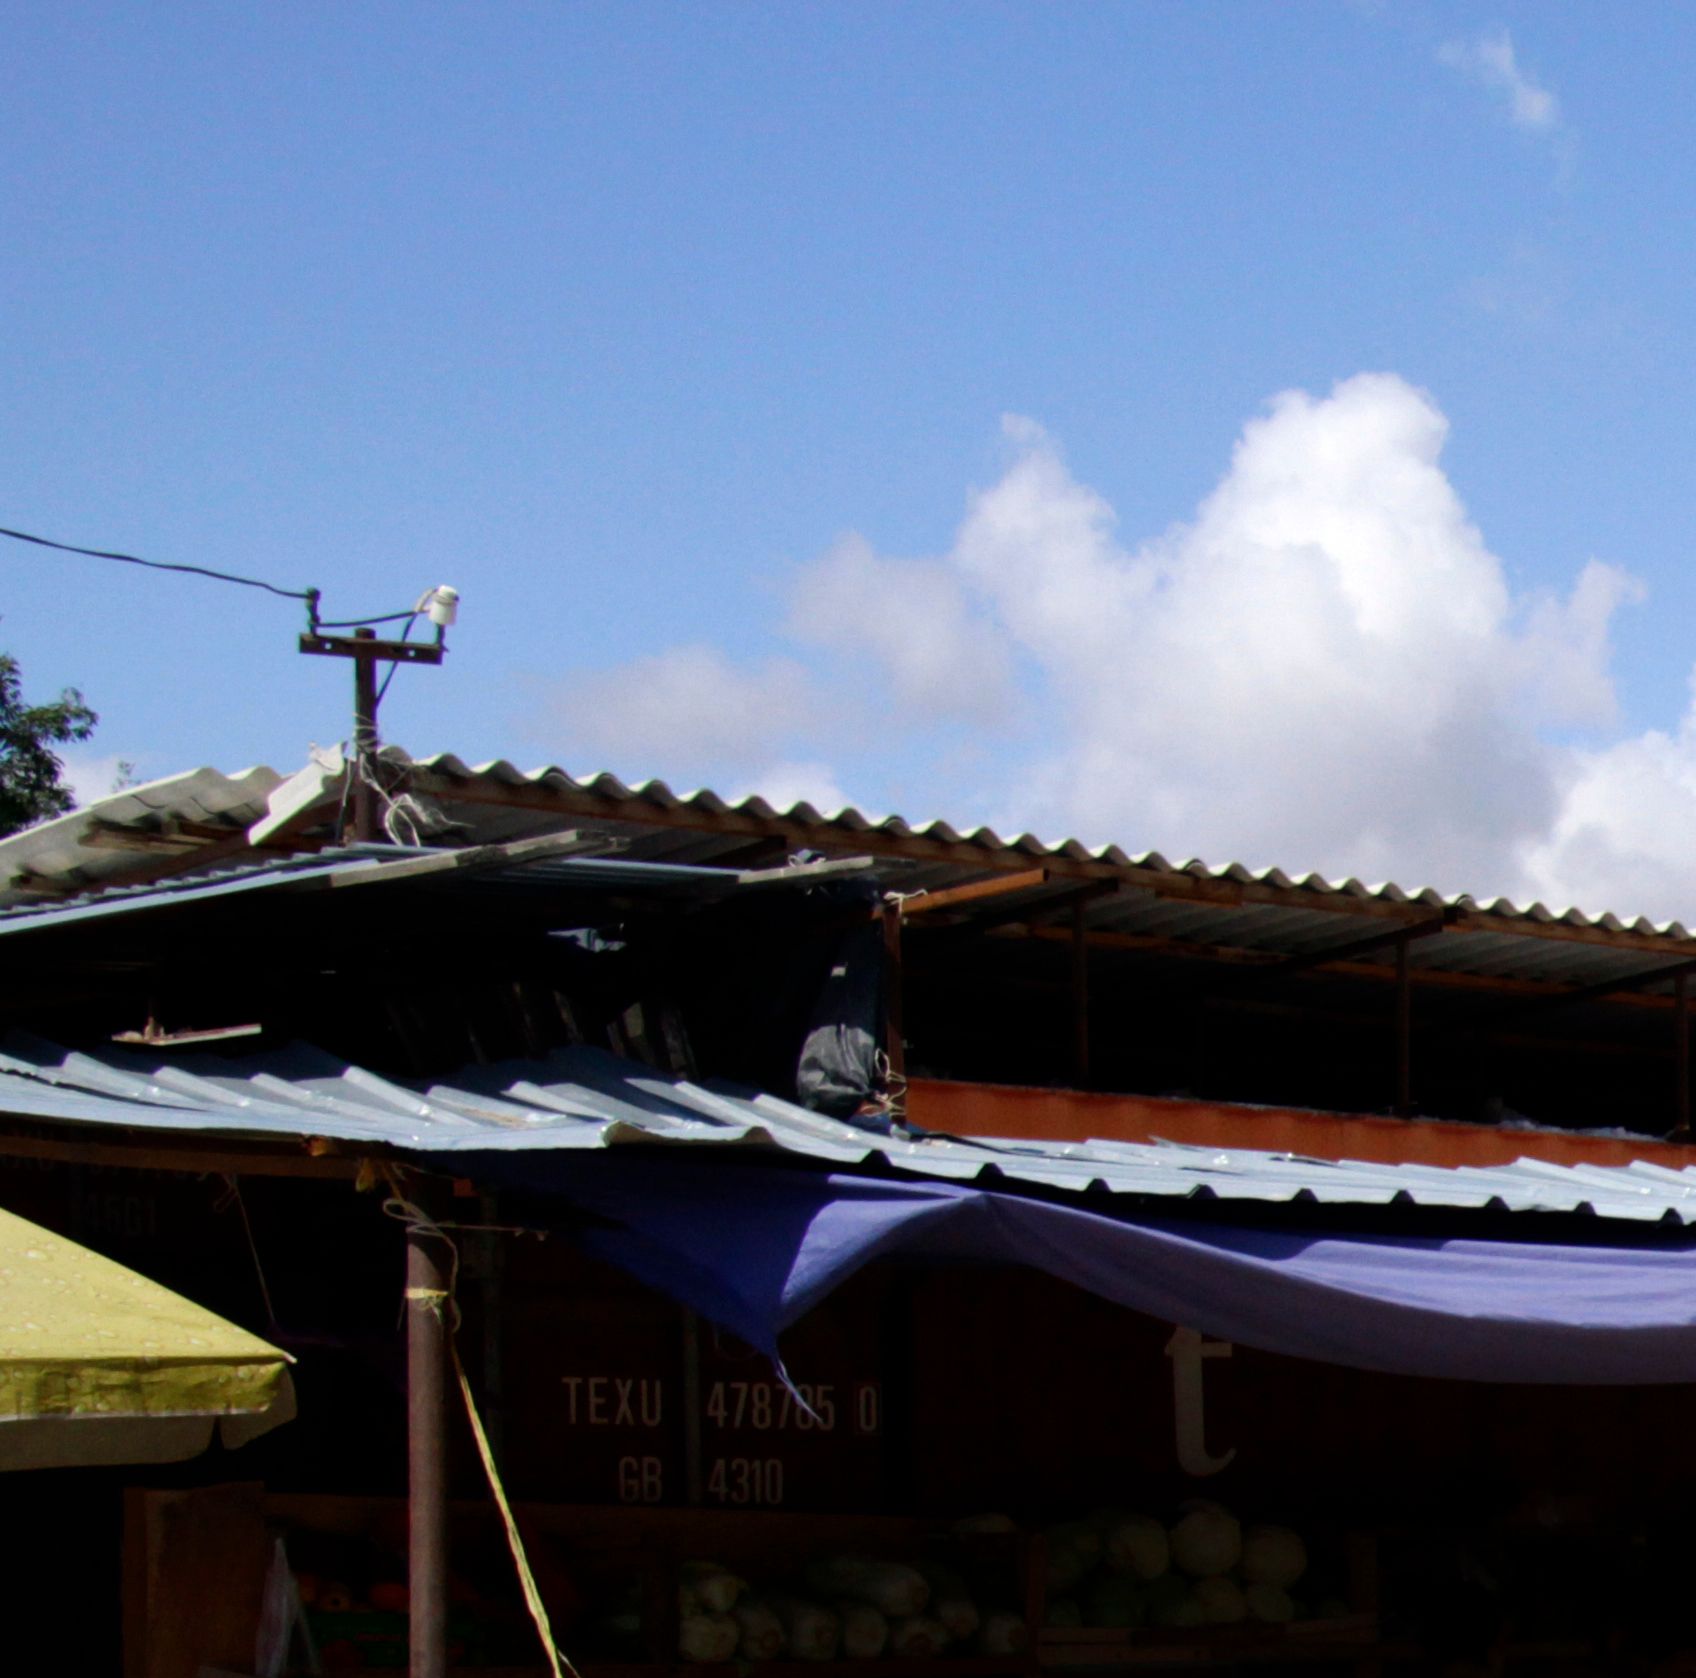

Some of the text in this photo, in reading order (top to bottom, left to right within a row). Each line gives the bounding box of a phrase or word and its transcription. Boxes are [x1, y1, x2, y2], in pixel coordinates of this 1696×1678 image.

[562, 1376, 662, 1427] TEXU
[706, 1381, 835, 1431] 478785
[1164, 1325, 1237, 1478] t
[618, 1456, 783, 1504] GB 4310
